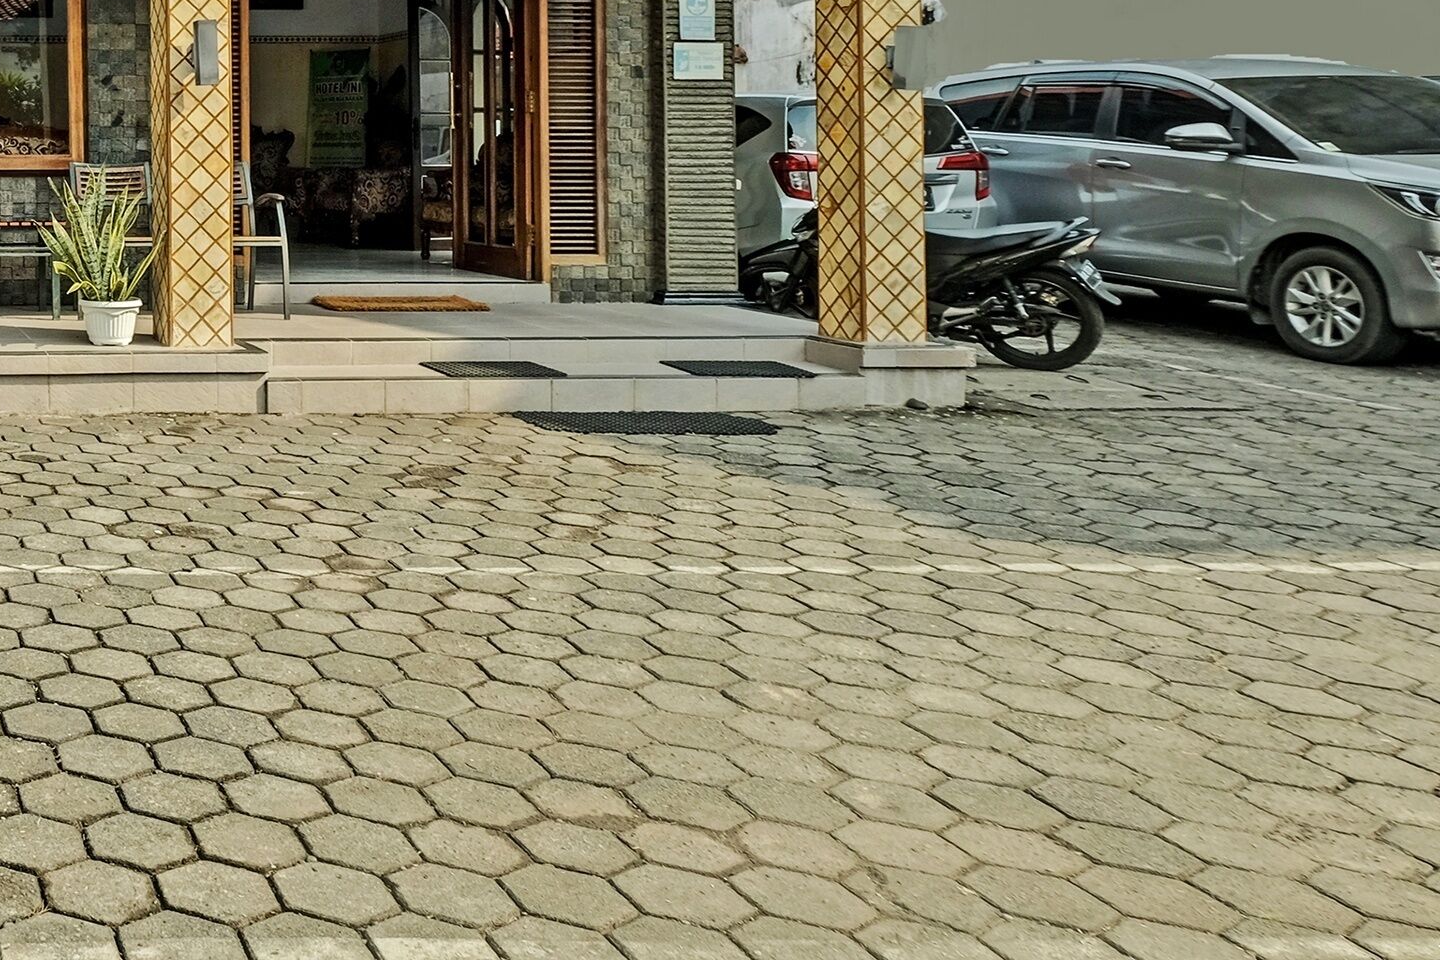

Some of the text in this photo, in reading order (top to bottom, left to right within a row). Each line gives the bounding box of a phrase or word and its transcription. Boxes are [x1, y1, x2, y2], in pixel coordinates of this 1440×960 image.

[315, 81, 362, 94] HOTEL INI
[335, 111, 364, 125] 10%
